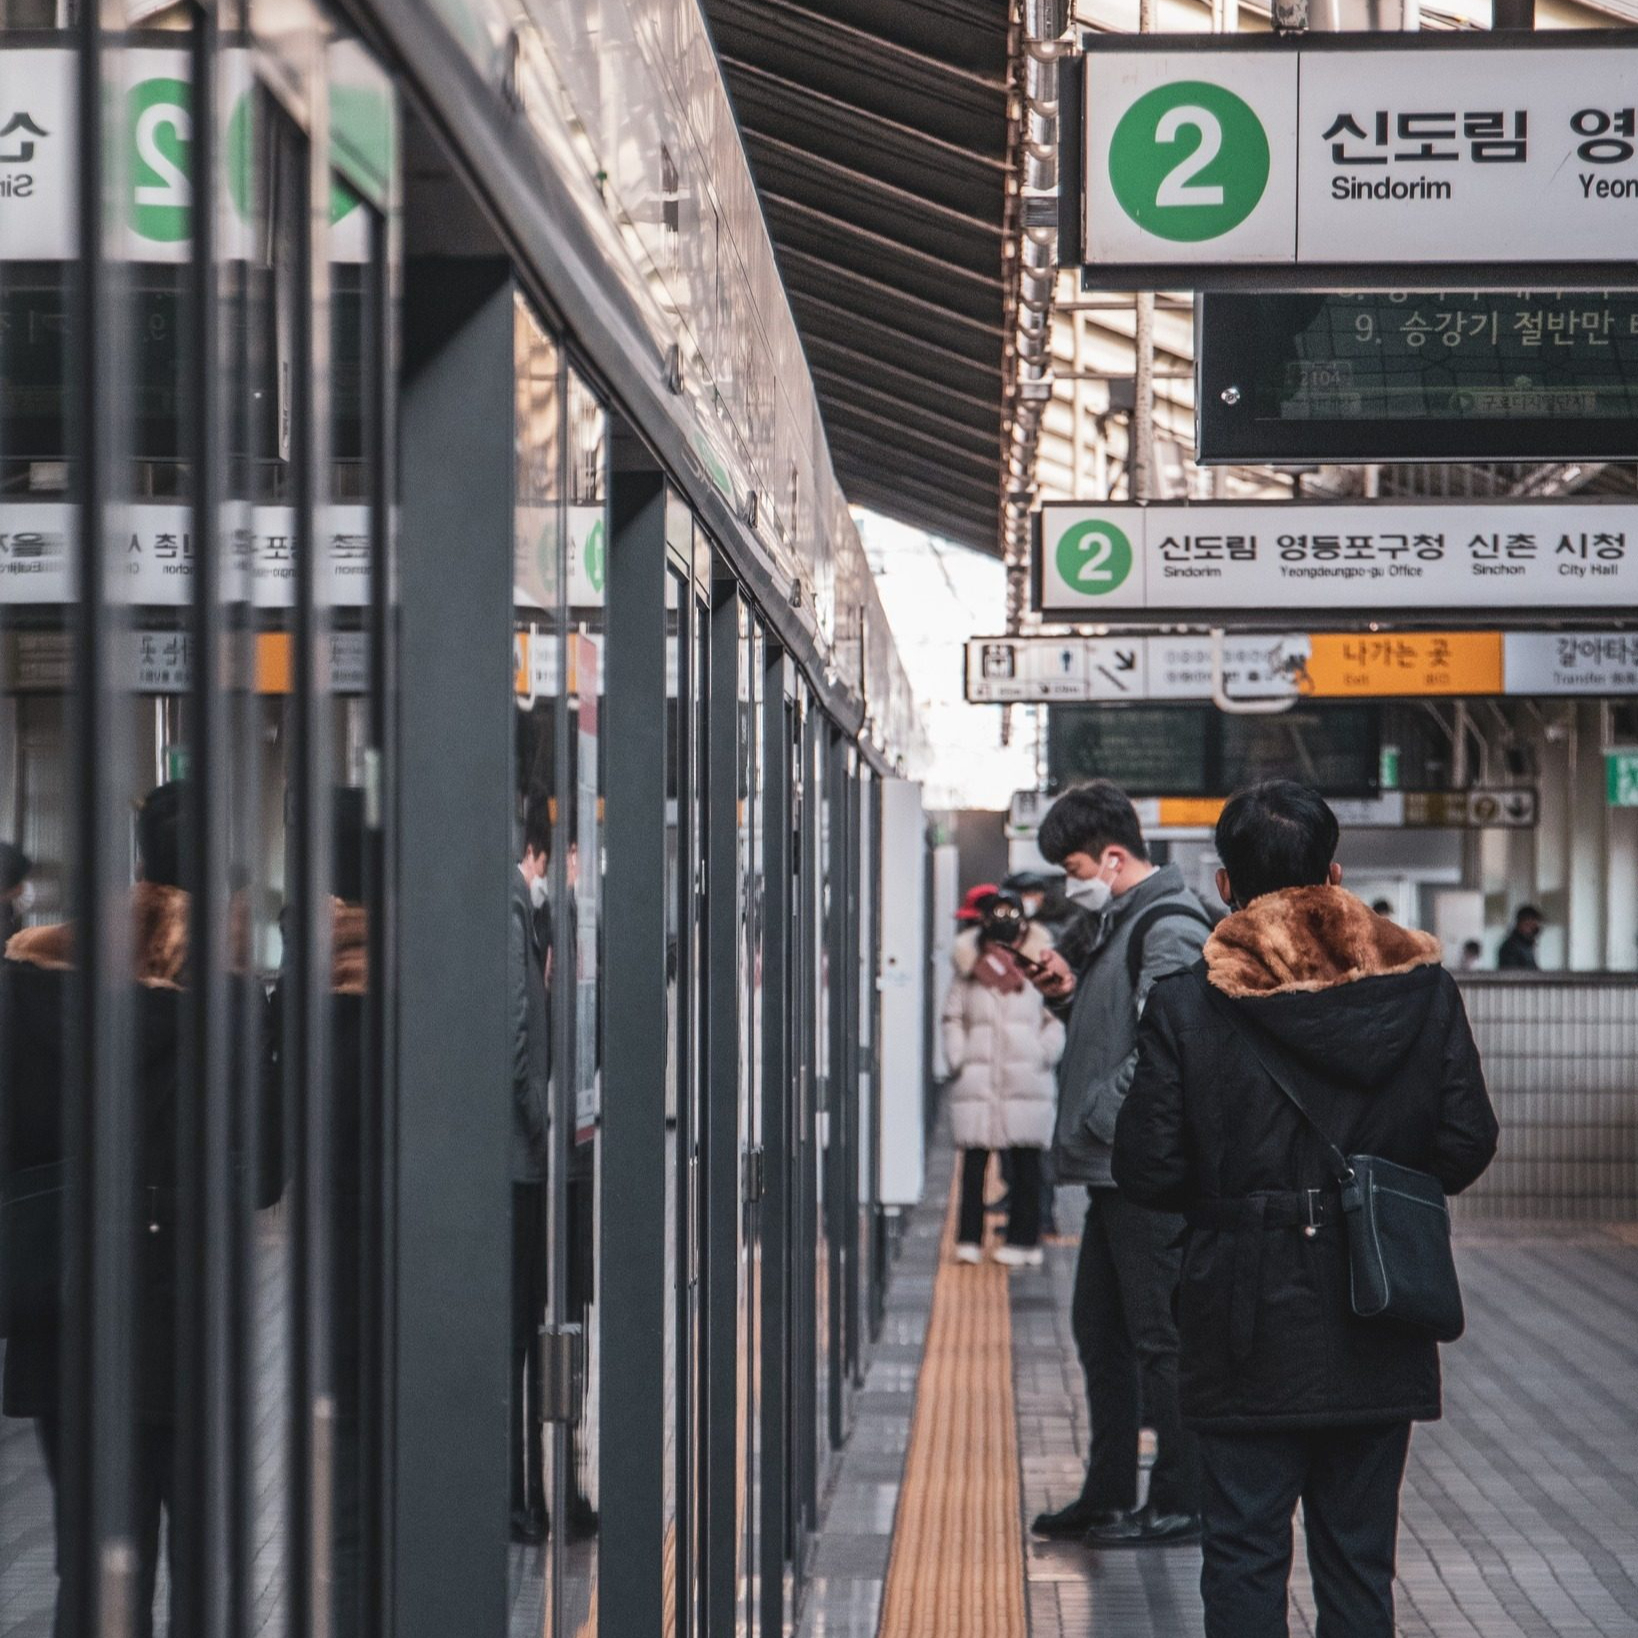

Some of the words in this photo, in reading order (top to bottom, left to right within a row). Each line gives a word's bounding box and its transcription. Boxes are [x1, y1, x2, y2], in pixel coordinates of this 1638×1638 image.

[1321, 110, 1528, 165] 신도림
[1570, 108, 1635, 165] 영
[1155, 105, 1224, 207] 2
[1331, 176, 1452, 200] Sindorim
[1354, 313, 1382, 345] 9.
[1400, 310, 1499, 347] 승강기
[1513, 309, 1615, 346] 절반만
[1078, 531, 1113, 581] 2
[1159, 535, 1257, 561] 신도림
[1276, 534, 1445, 561] 영등포구청
[1468, 533, 1538, 560] 신촌
[1555, 533, 1626, 560] 시청
[1163, 565, 1222, 578] Sindorim
[1280, 566, 1385, 580] Yeongdeungpo-gu
[1389, 564, 1423, 578] Office
[1472, 563, 1526, 577] Sinchon
[1558, 563, 1587, 578] City
[1591, 563, 1619, 576] Hall
[1342, 638, 1417, 669] 나가는
[1429, 638, 1453, 668] 곳
